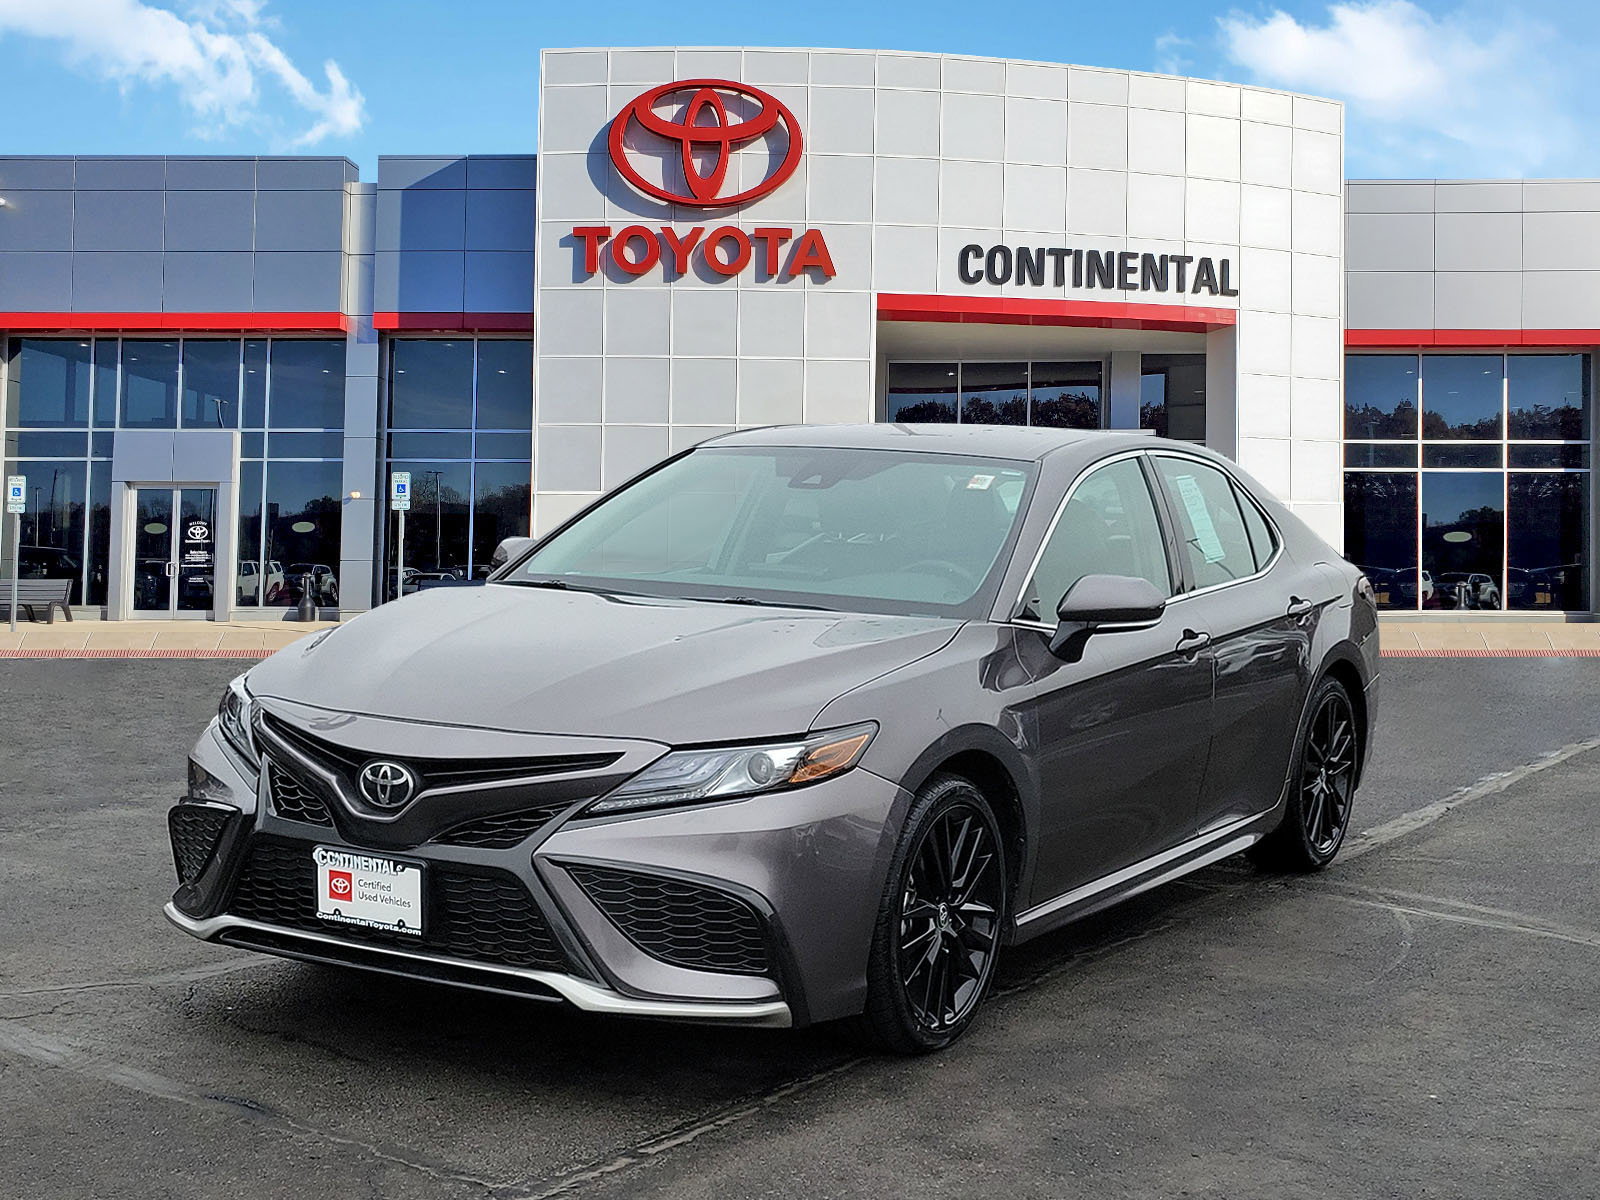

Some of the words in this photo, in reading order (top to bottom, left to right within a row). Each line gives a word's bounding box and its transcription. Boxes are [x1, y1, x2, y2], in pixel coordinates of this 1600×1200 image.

[572, 225, 837, 277] TOYOTA
[958, 244, 1239, 297] CONTINENTAL
[319, 850, 398, 875] CONTINENTAL
[358, 878, 392, 892] Certified
[358, 891, 378, 903] Used
[379, 895, 412, 908] Vehicles
[316, 912, 421, 935] ContinentalToyota.com
